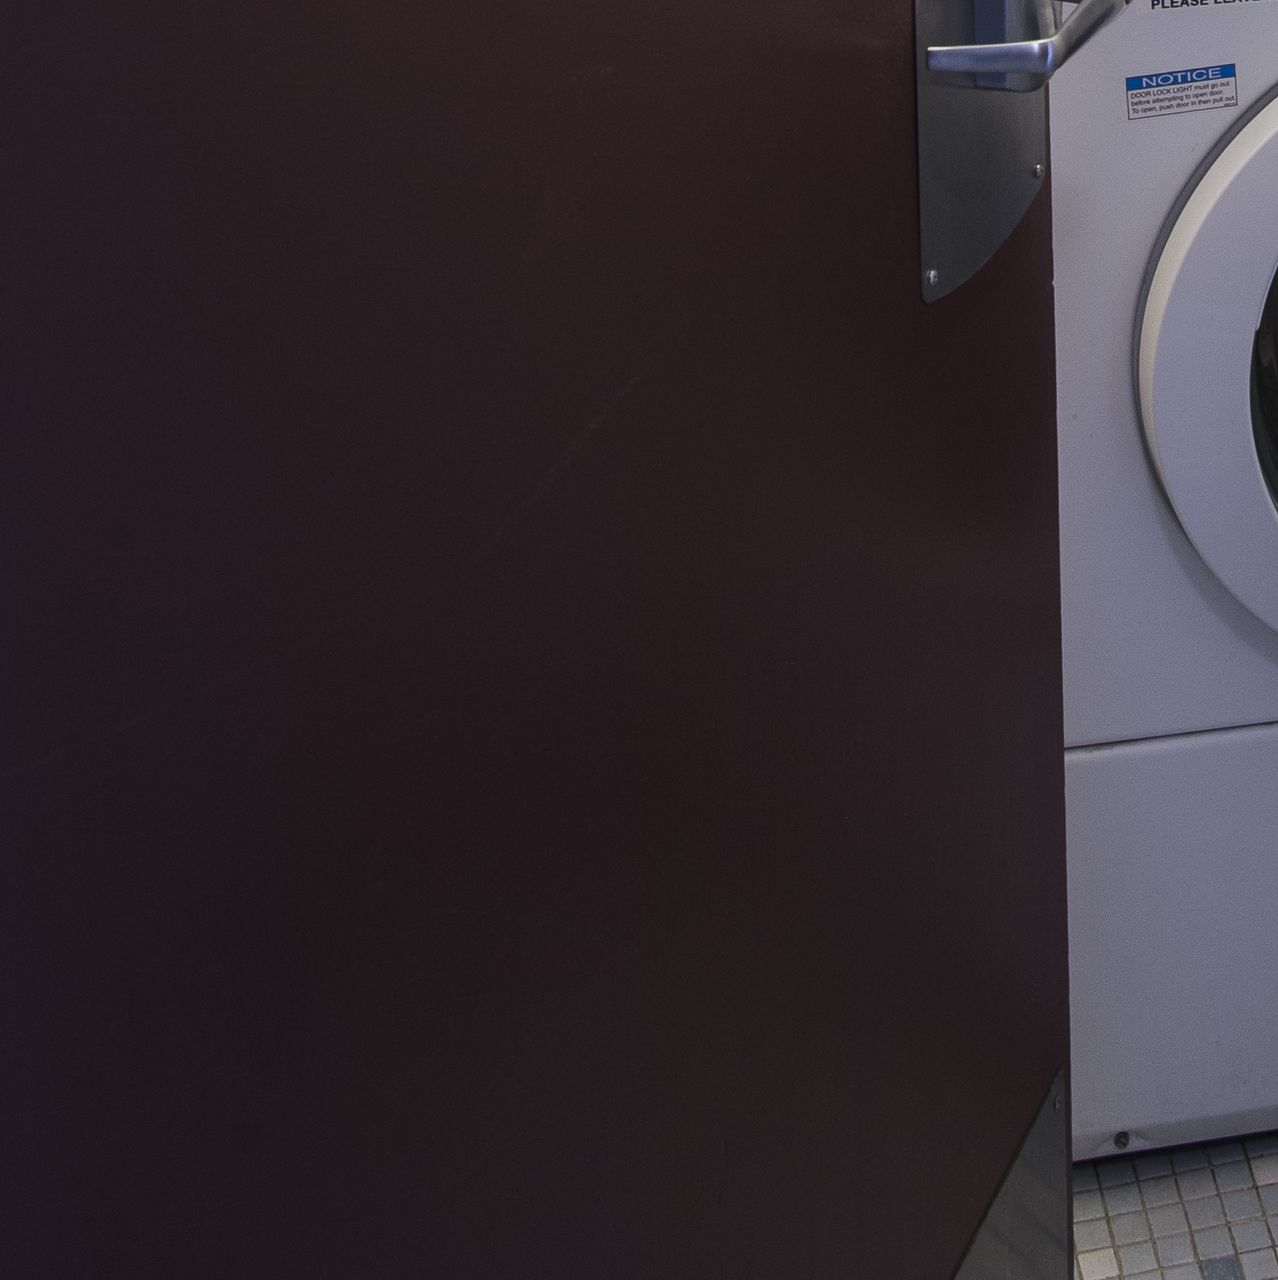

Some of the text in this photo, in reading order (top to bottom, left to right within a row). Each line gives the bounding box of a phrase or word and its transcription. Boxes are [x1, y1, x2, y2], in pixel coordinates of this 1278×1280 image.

[1142, 67, 1222, 88] NOTICE
[1130, 90, 1152, 99] DOOR
[1153, 88, 1172, 97] LOCK
[1173, 86, 1192, 94] LIGHT
[1131, 99, 1151, 107] before
[1152, 95, 1184, 104] attempting
[1192, 91, 1208, 99] open
[1159, 103, 1174, 111] push
